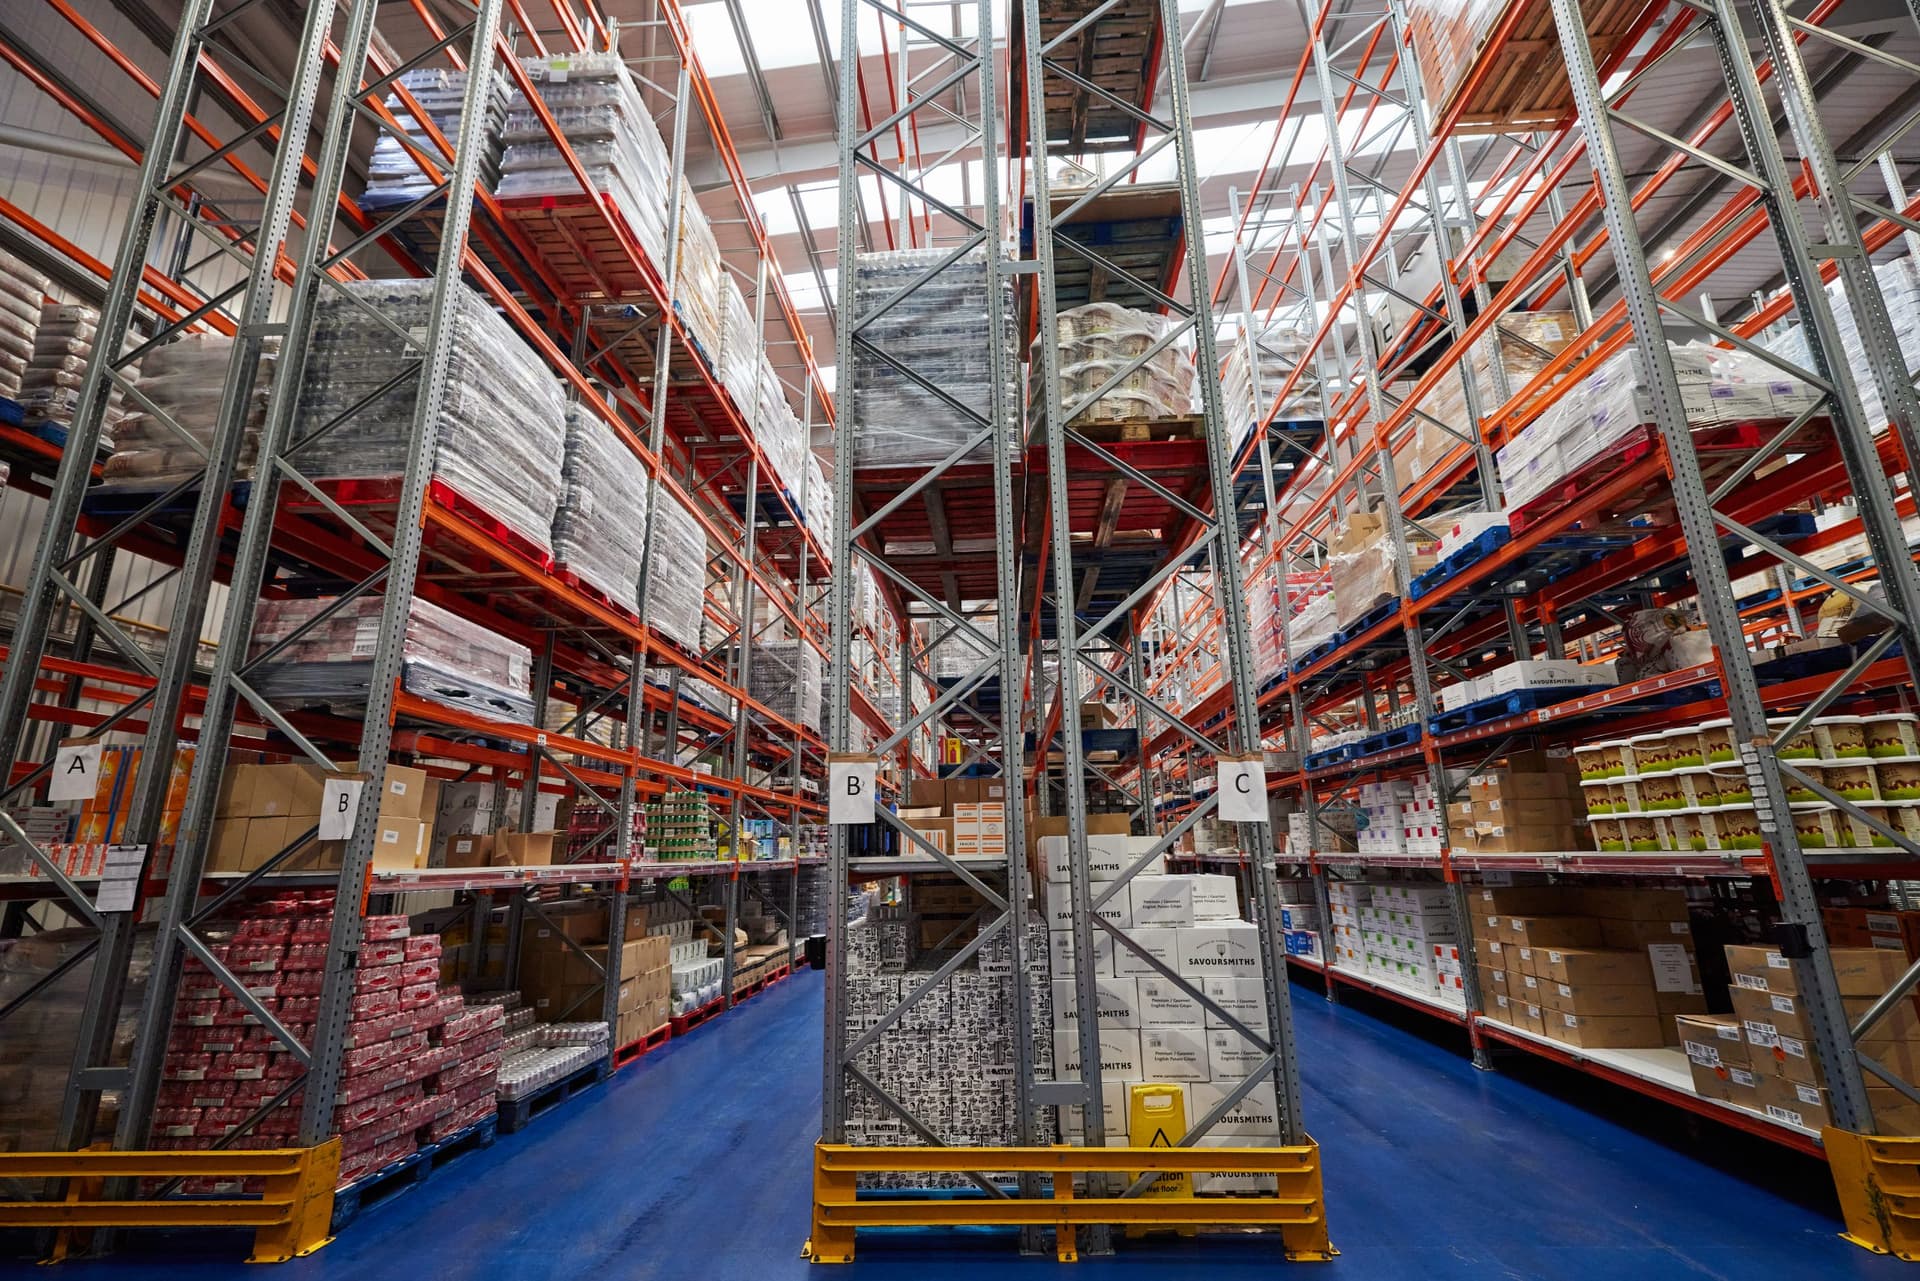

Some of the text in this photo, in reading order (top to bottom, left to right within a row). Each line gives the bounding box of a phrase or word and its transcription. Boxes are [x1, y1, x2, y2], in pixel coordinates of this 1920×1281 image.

[67, 755, 85, 774] A
[847, 776, 860, 795] B
[1235, 774, 1250, 793] C
[338, 793, 349, 812] B
[1188, 958, 1255, 966] SAVOURSMITHS
[1210, 1171, 1278, 1179] SAVOURSMITH
